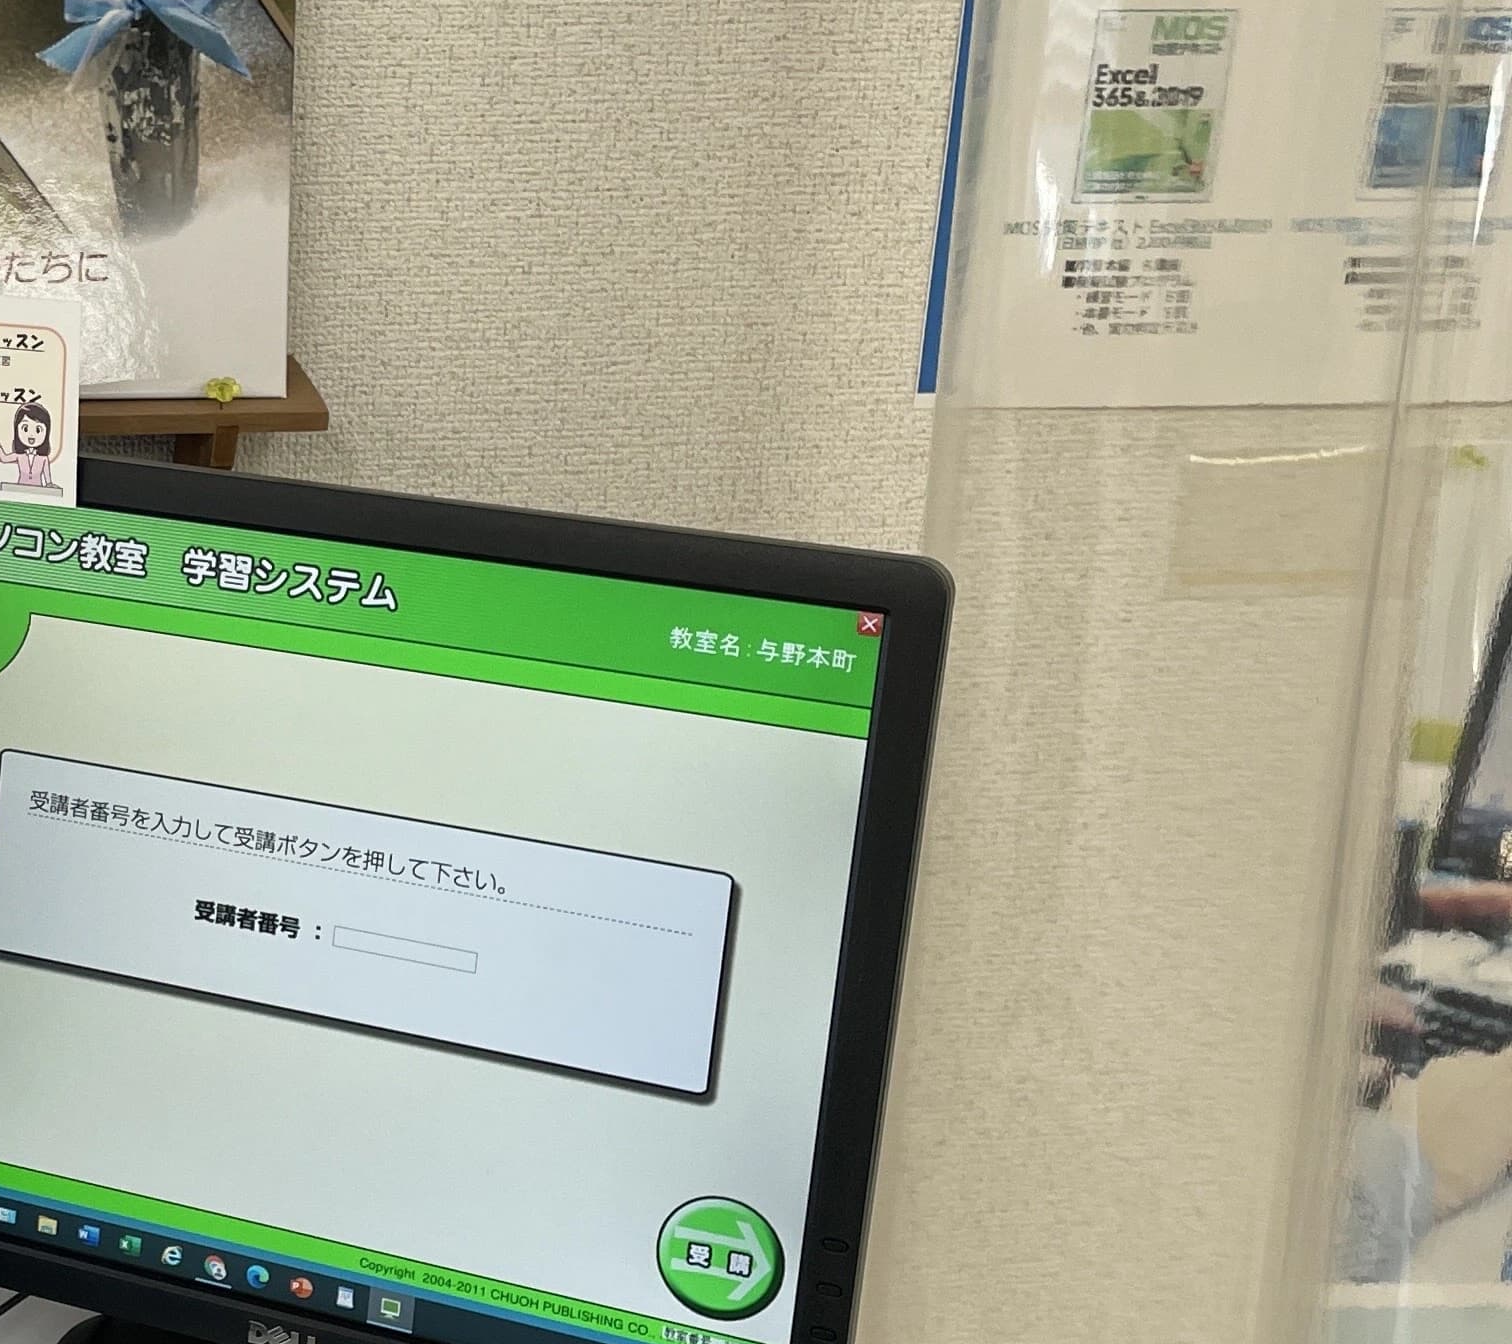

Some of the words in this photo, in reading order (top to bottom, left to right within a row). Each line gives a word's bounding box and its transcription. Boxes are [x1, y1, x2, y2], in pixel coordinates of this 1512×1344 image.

[1094, 62, 1160, 86] Excel
[181, 547, 399, 612] 学習システム
[359, 1256, 417, 1282] Copyright
[422, 1272, 487, 1298] 2004-2011
[490, 1288, 541, 1311] CHUOH
[542, 1301, 625, 1332] PUBLISHING
